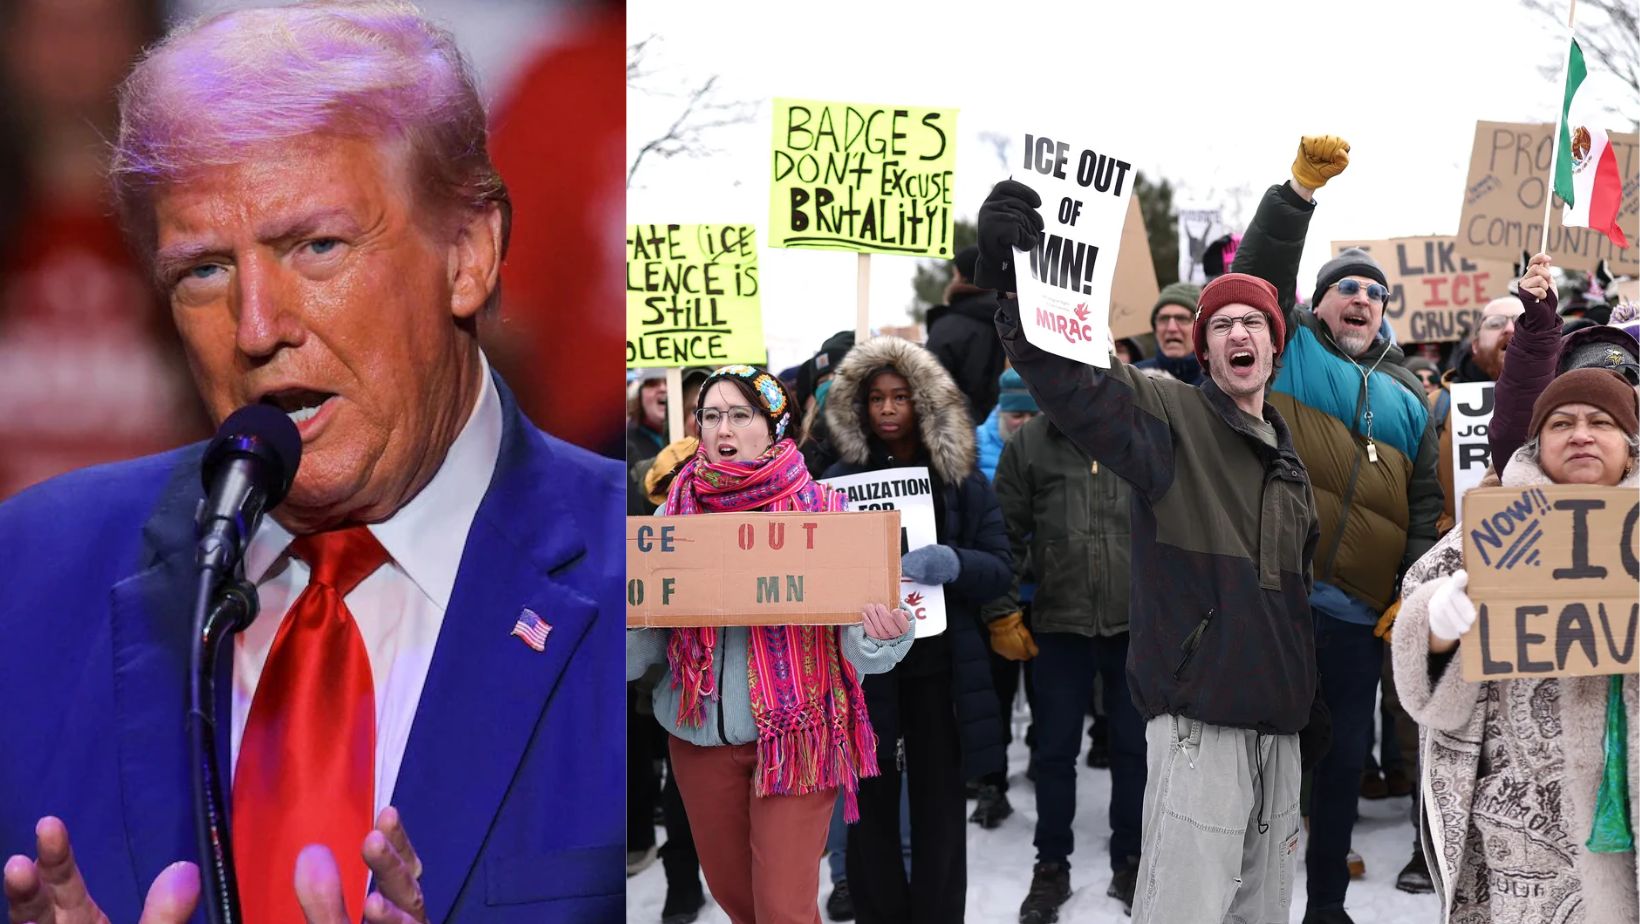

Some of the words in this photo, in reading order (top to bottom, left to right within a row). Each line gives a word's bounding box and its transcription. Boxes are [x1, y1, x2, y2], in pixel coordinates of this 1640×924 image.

[787, 106, 946, 161] BADGES
[881, 160, 953, 206] EXCUSE
[1023, 133, 1070, 180] ICE
[1076, 149, 1131, 197] OUT
[1058, 197, 1083, 226] OF
[1468, 214, 1639, 264] COMMUNITIE
[627, 261, 724, 295] LENCE
[1030, 232, 1099, 296] MN!
[1422, 272, 1490, 307] ICE
[1036, 307, 1092, 344] MIRAC
[738, 522, 818, 550] OUT
[1471, 488, 1551, 567] NOW!!
[628, 578, 676, 606] OF
[756, 575, 804, 604] MN
[1479, 602, 1639, 676] LEAV
